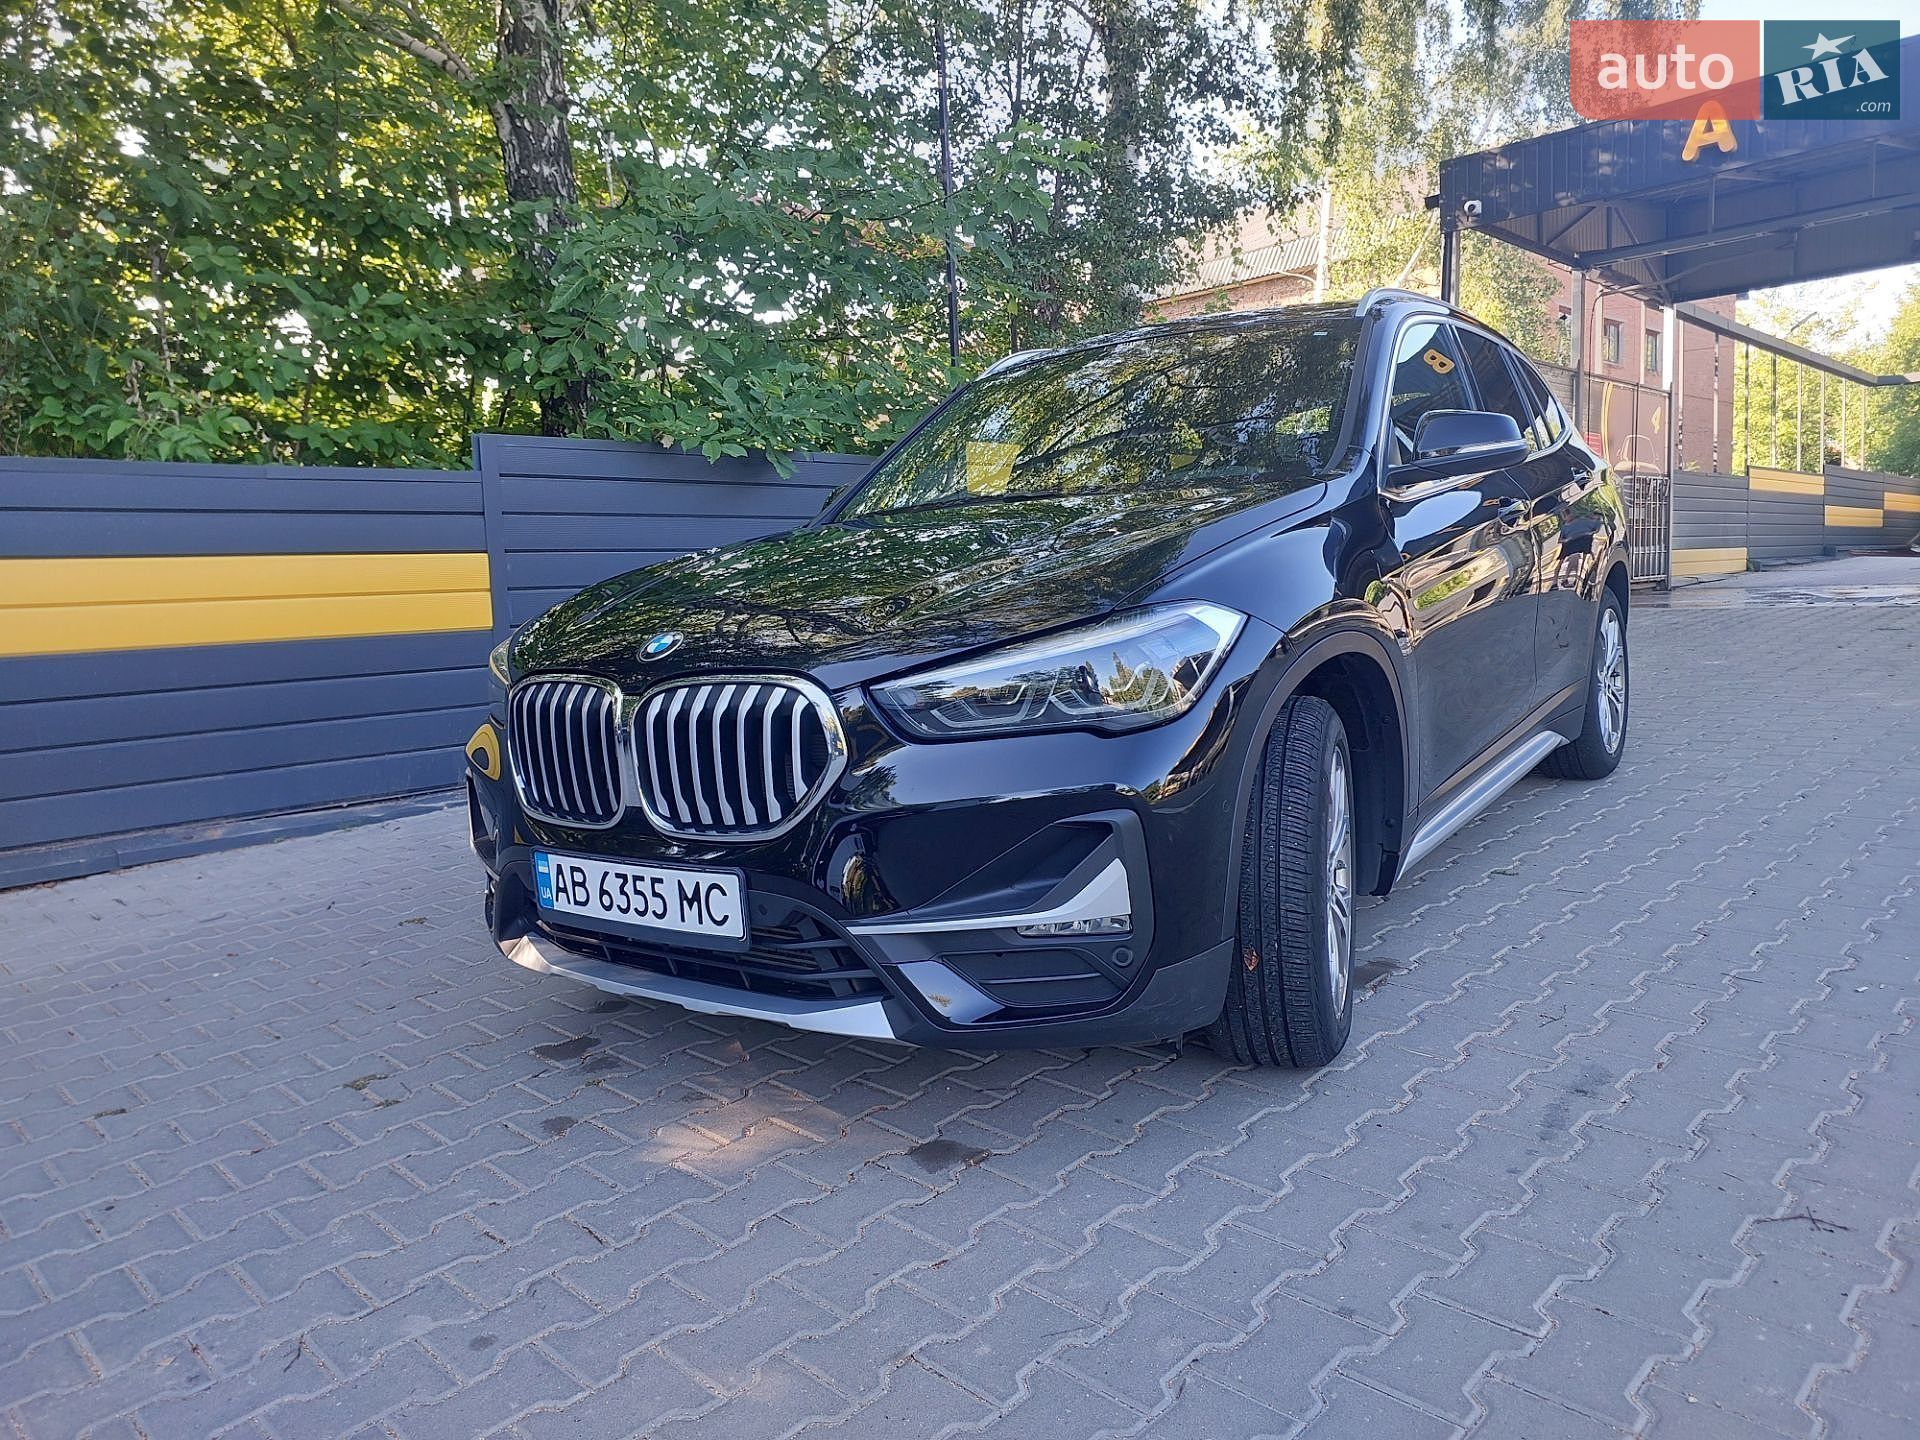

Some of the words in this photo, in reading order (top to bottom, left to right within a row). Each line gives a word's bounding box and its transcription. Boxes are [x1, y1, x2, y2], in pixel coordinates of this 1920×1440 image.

[540, 886, 553, 900] UA
[555, 863, 590, 907] AB
[599, 870, 668, 920] 6355
[677, 878, 730, 927] MC
